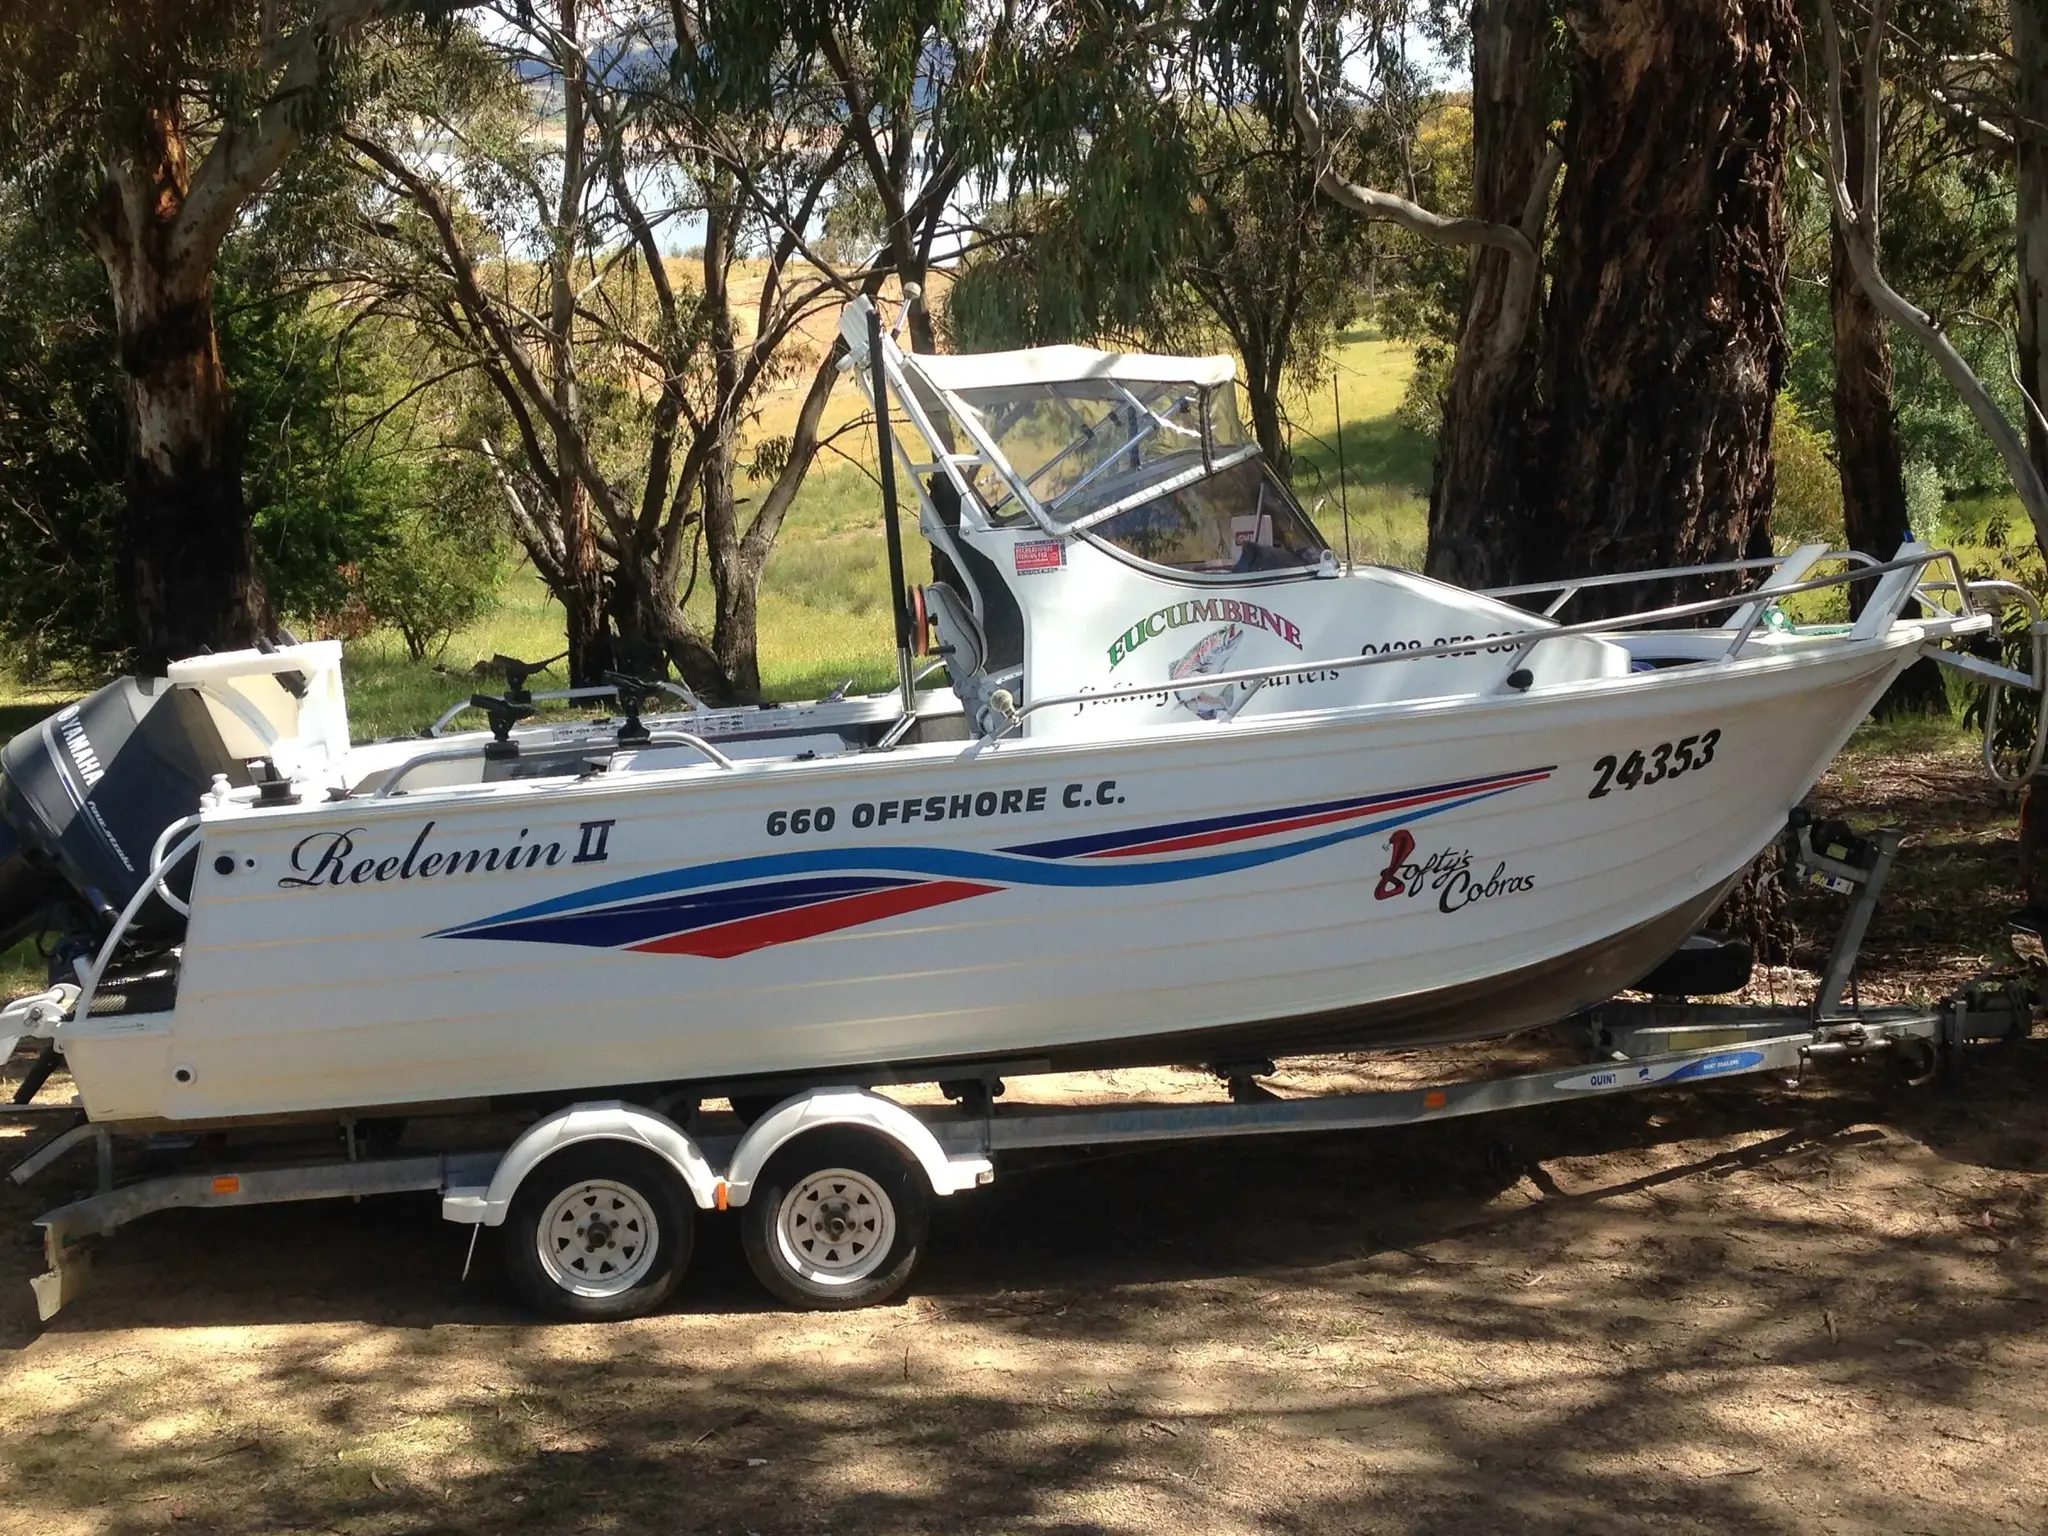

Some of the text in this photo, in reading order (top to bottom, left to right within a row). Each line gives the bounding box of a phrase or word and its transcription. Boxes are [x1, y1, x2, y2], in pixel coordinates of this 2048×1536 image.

[1106, 598, 1303, 673] EUCUMBENE
[60, 716, 105, 787] YAMAHA
[1588, 728, 1721, 799] 24353
[766, 780, 1126, 837] 660 OFFSHORE C.C.
[278, 819, 616, 889] Reelemin II
[1439, 861, 1536, 914] Cobras
